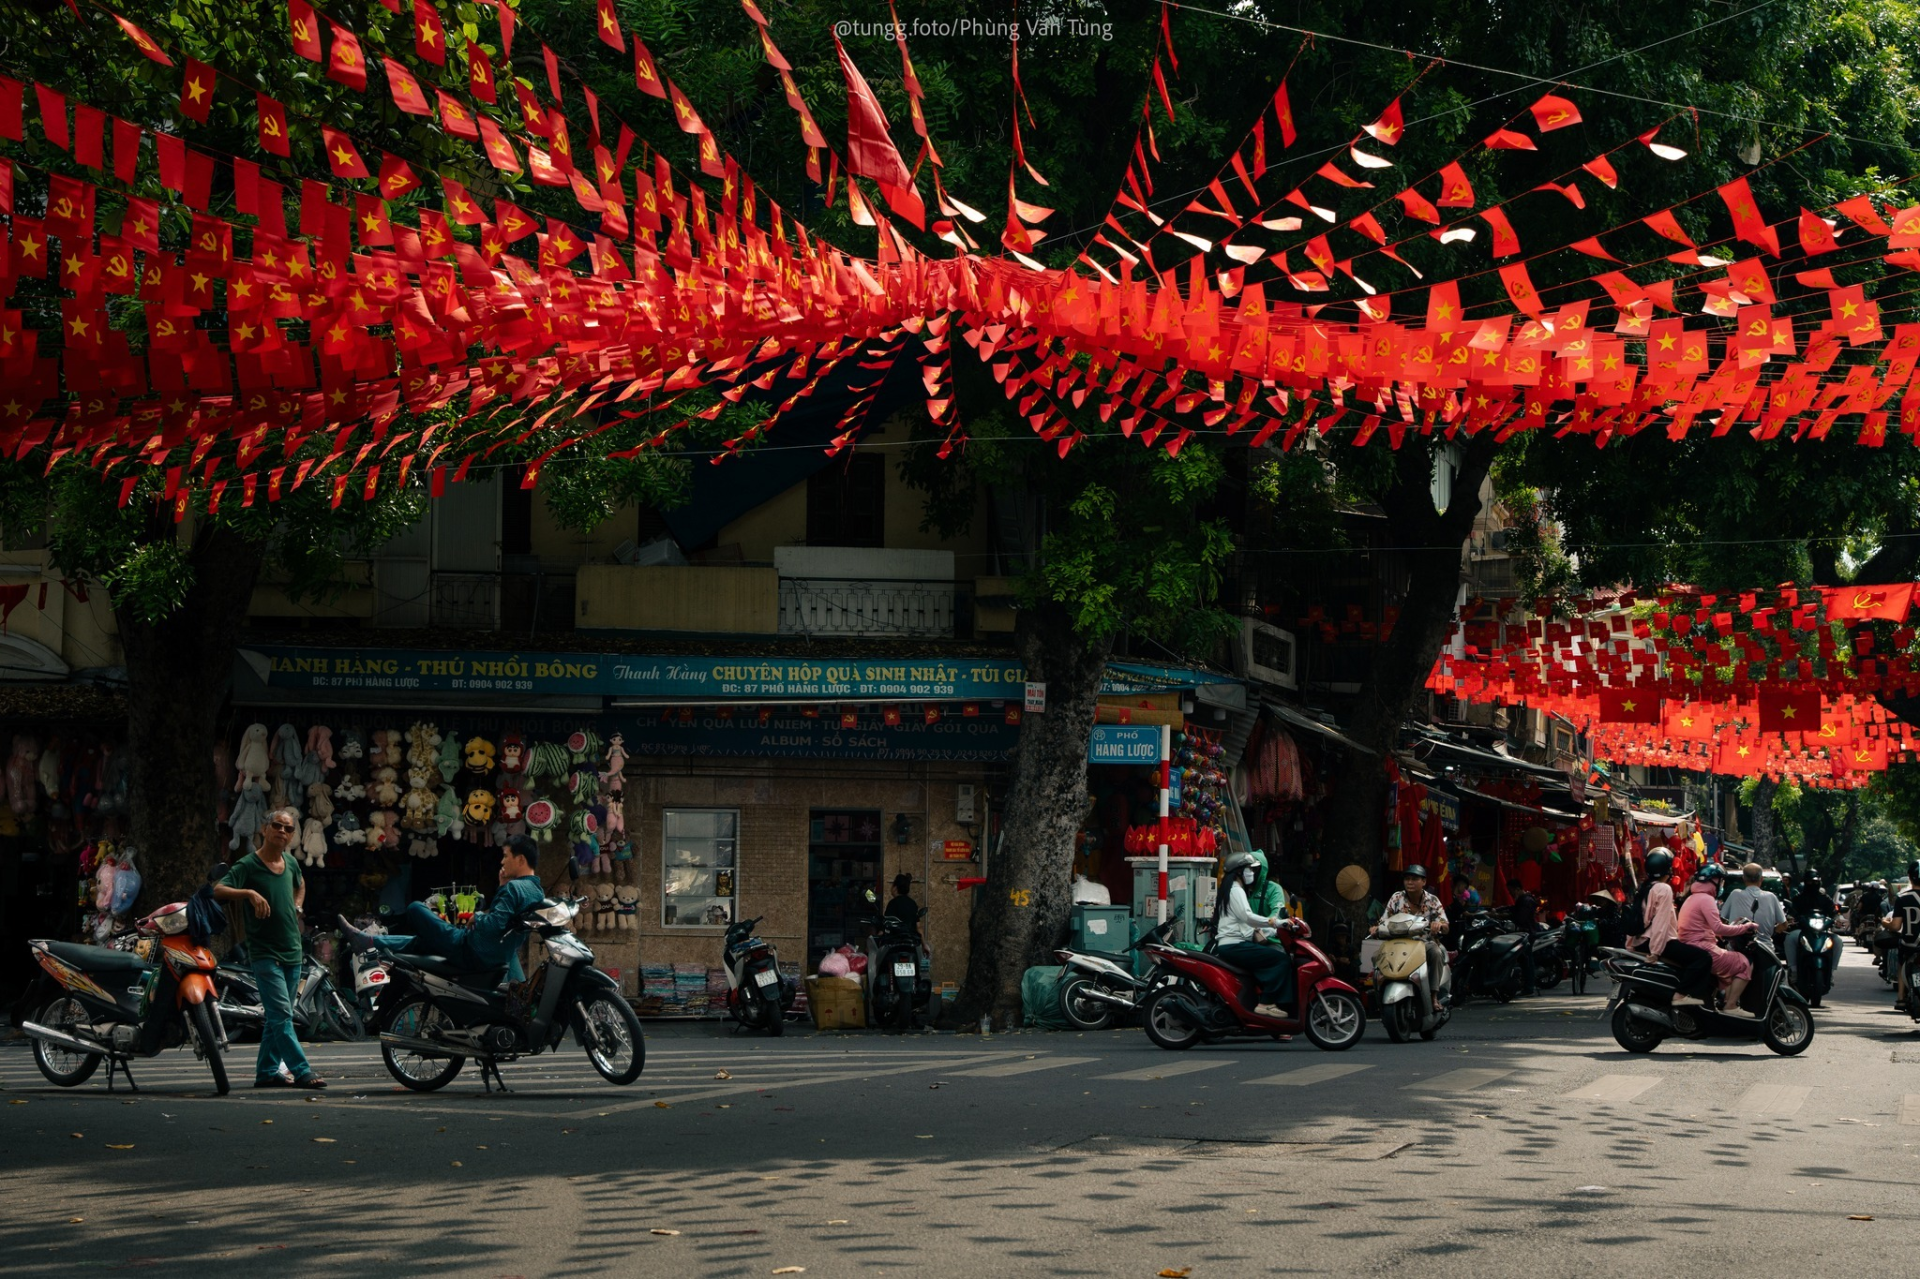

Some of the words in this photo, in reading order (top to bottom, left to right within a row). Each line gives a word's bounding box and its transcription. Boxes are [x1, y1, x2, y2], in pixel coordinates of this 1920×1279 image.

[417, 656, 465, 676] THÚ
[471, 655, 528, 677] NHỒI
[534, 658, 598, 679] BÔNG
[613, 664, 661, 680] Thanh
[665, 663, 708, 684] Hằng
[712, 662, 783, 681] CHUYÊN
[787, 662, 822, 684] HỘP
[826, 663, 861, 684] QUÀ
[865, 666, 906, 681] SINH
[910, 663, 958, 685] NHẬT
[971, 664, 999, 683] TÚI
[313, 676, 329, 686] ĐC:
[331, 677, 342, 686] 87
[365, 675, 392, 687] HÀNG
[395, 677, 420, 690] LƯỢC
[452, 679, 467, 689] ĐT:
[469, 679, 493, 689] 0904
[495, 680, 513, 690] 902
[515, 681, 533, 690] 939
[722, 684, 741, 694] ĐC:
[744, 684, 758, 694] 87
[761, 681, 784, 694] PHỐ
[787, 683, 818, 694] HÀNG
[822, 683, 850, 696] LƯỢC
[860, 684, 877, 694] ĐT:
[880, 684, 907, 694] 0904
[910, 685, 931, 694] 902
[933, 685, 954, 694] 939
[760, 735, 812, 746] ALBUM
[848, 734, 887, 748] SÁCH
[1116, 729, 1139, 739] PHỐ
[1095, 741, 1124, 757] HÀNG
[1127, 743, 1154, 760] LƯỢC
